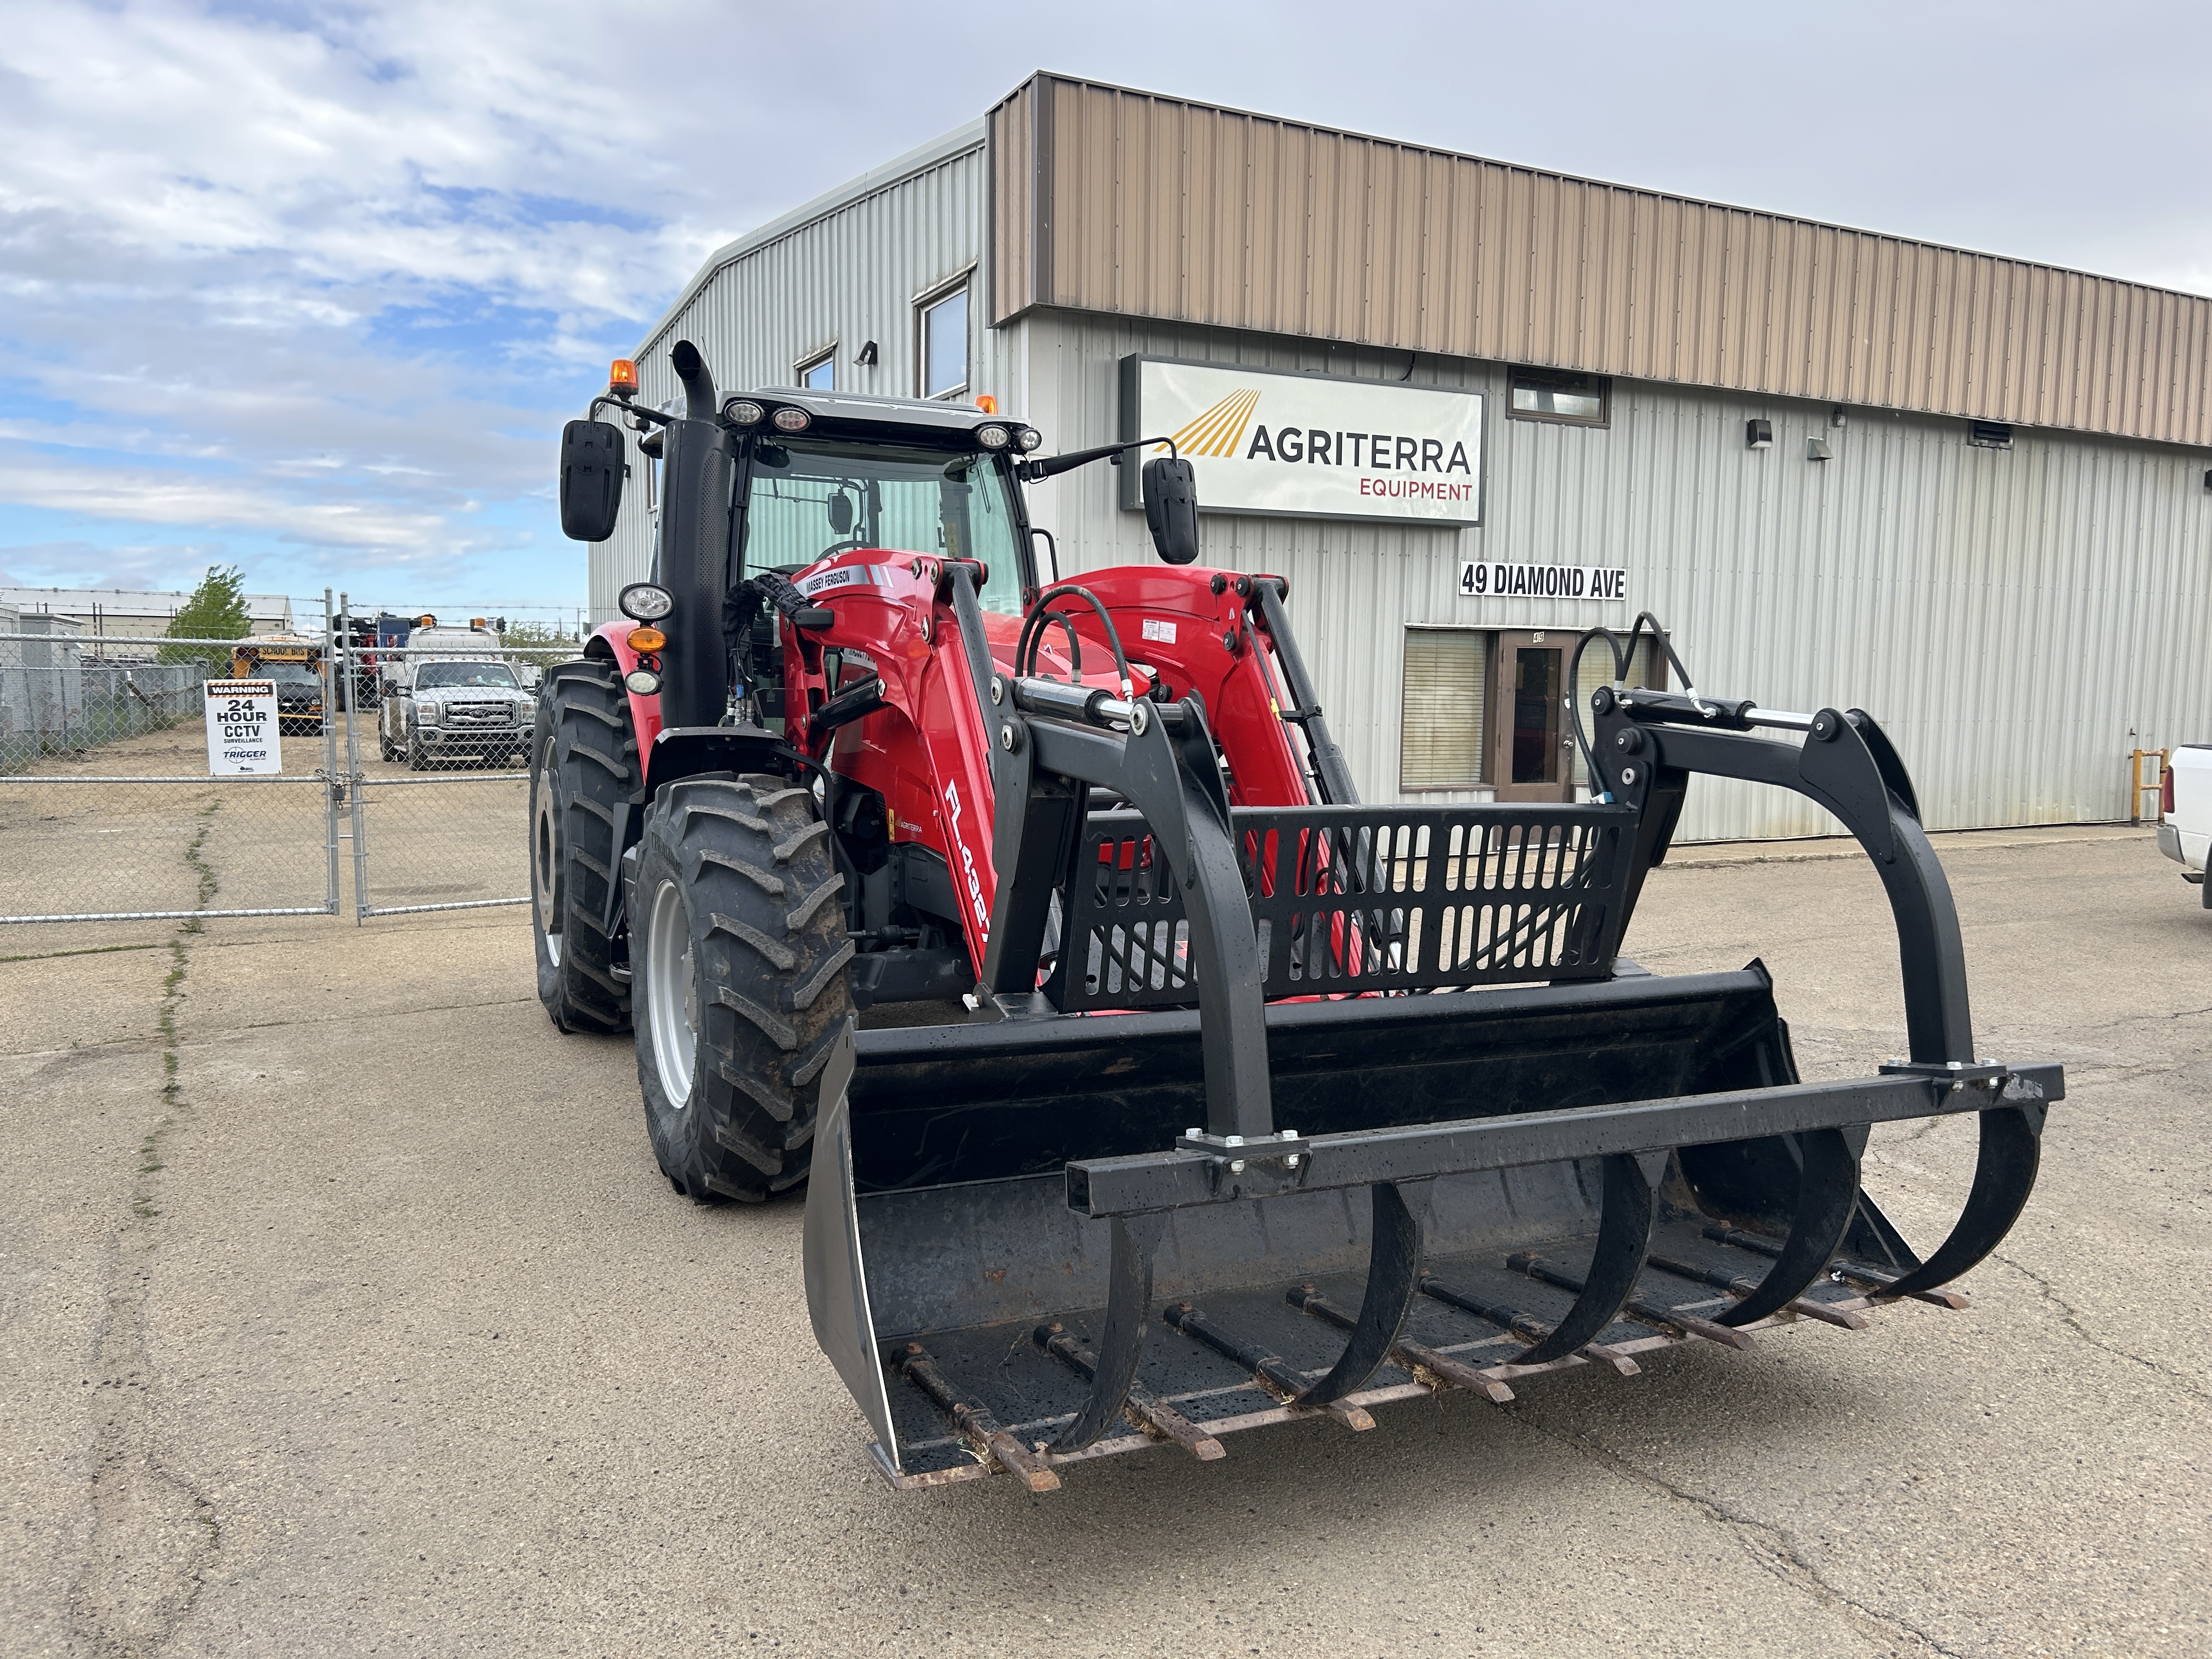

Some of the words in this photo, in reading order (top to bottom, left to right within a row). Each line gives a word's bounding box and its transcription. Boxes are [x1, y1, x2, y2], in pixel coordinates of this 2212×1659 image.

[1246, 425, 1471, 475] AGRITERRA
[1359, 478, 1472, 501] EQUIPMENT
[806, 577, 824, 594] MASSEY
[825, 569, 850, 588] FERGUSON
[1462, 564, 1487, 594] 49
[1494, 565, 1584, 596] DIAMOND
[1589, 569, 1626, 598] AVE
[1533, 633, 1543, 642] 49
[291, 647, 305, 656] BUS
[228, 699, 255, 711] 24
[217, 712, 267, 722] HOUR
[224, 725, 260, 737] CCTV
